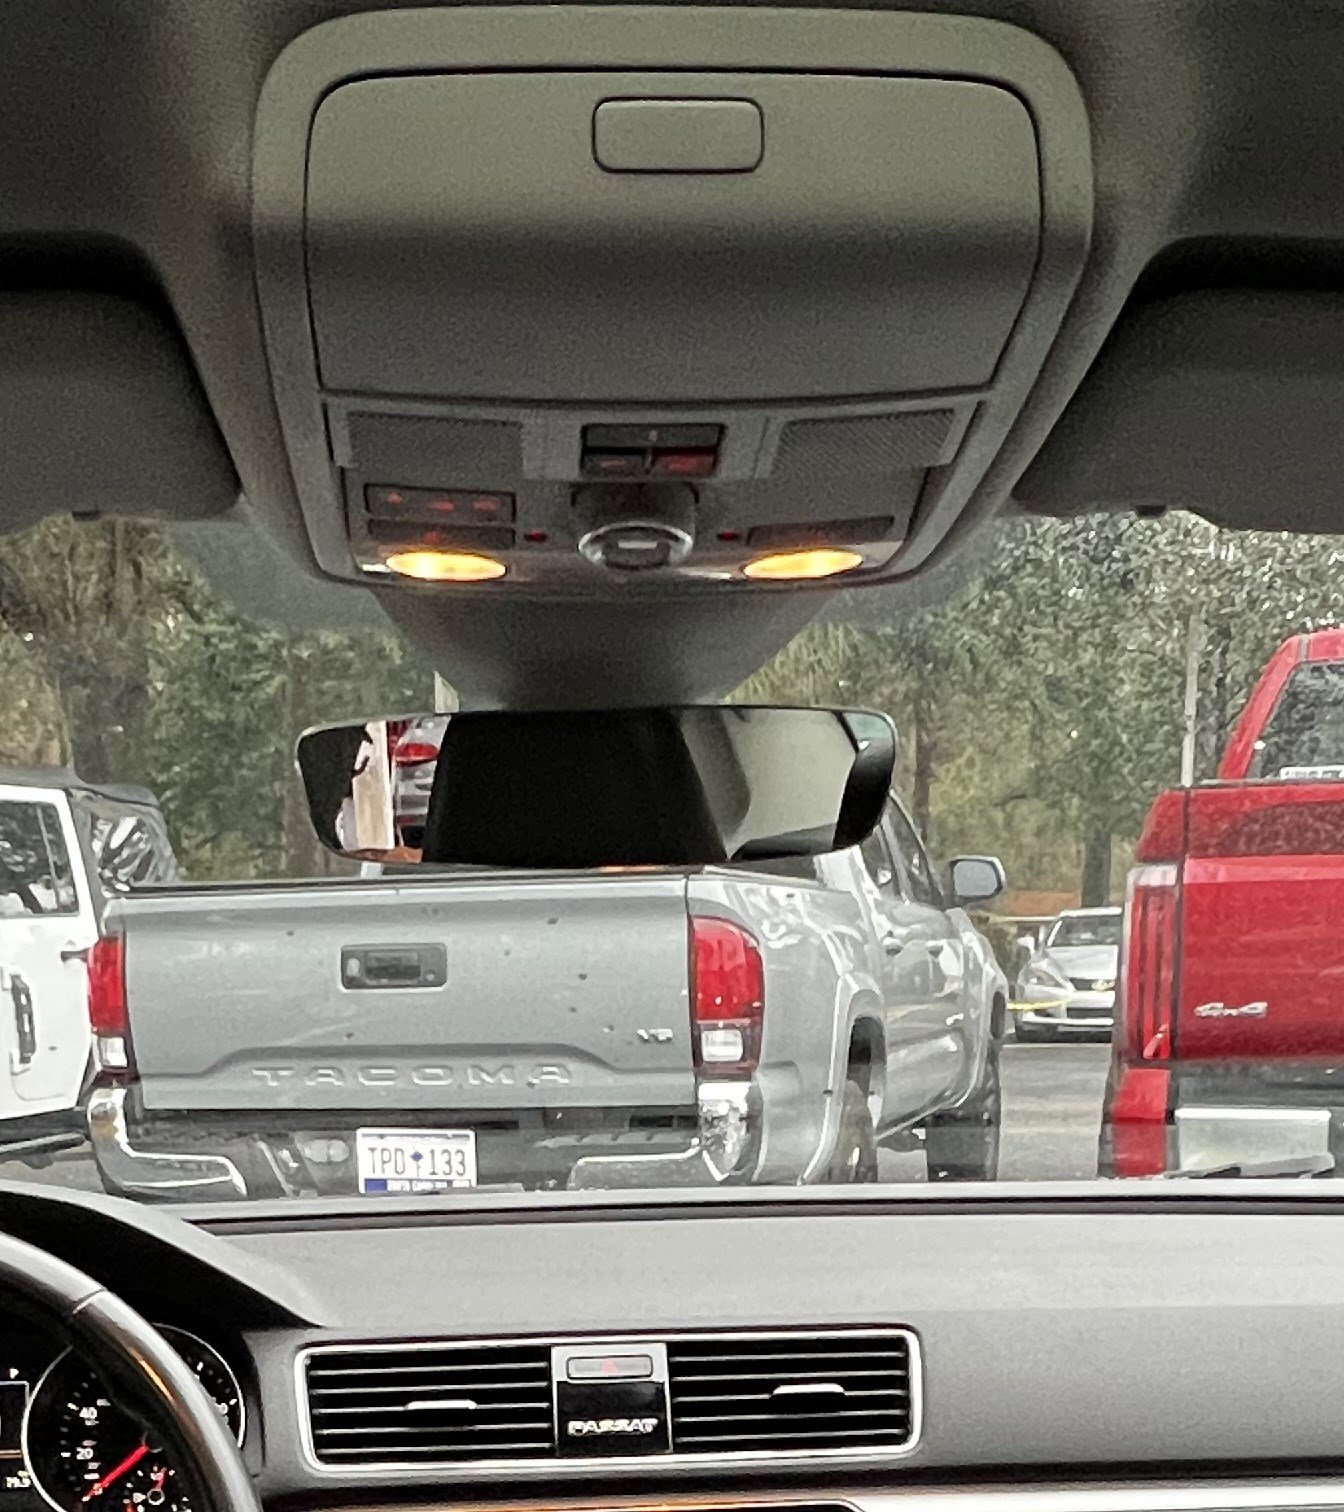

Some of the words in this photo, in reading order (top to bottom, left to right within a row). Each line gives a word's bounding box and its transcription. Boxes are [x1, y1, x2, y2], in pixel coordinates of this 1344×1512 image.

[252, 1064, 571, 1087] TACOMA
[428, 1148, 466, 1176] 133
[567, 1418, 659, 1436] PASSAT
[76, 1447, 94, 1460] 20
